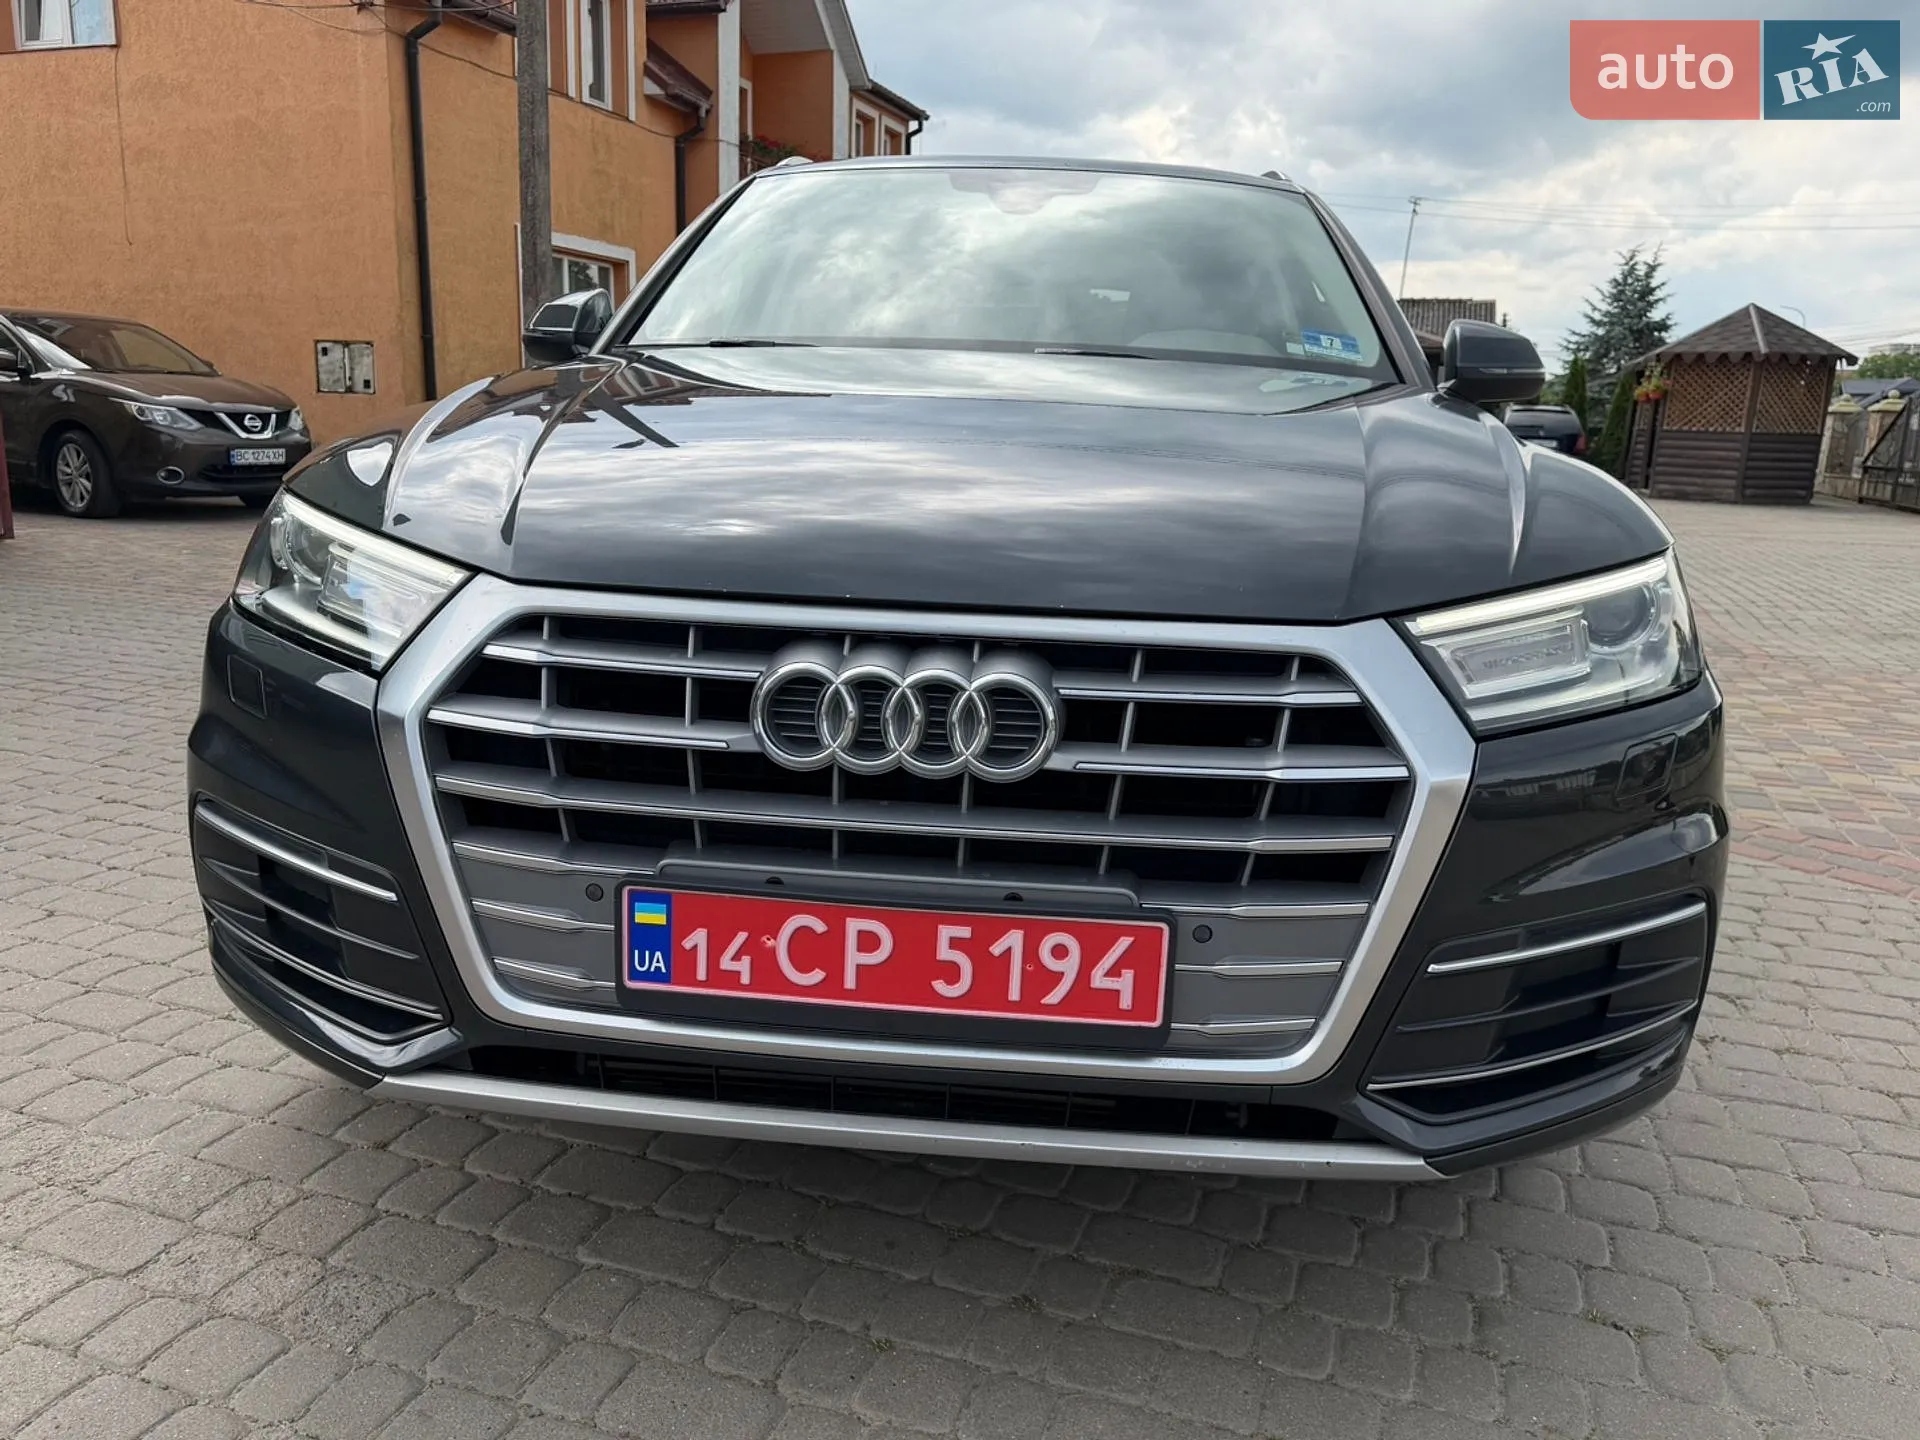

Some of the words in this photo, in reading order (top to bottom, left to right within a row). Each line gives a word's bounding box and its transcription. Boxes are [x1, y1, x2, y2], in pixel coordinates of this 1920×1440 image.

[634, 949, 667, 974] UA
[681, 928, 752, 985] 14
[775, 914, 894, 990] CP
[931, 925, 1135, 1010] 5194
